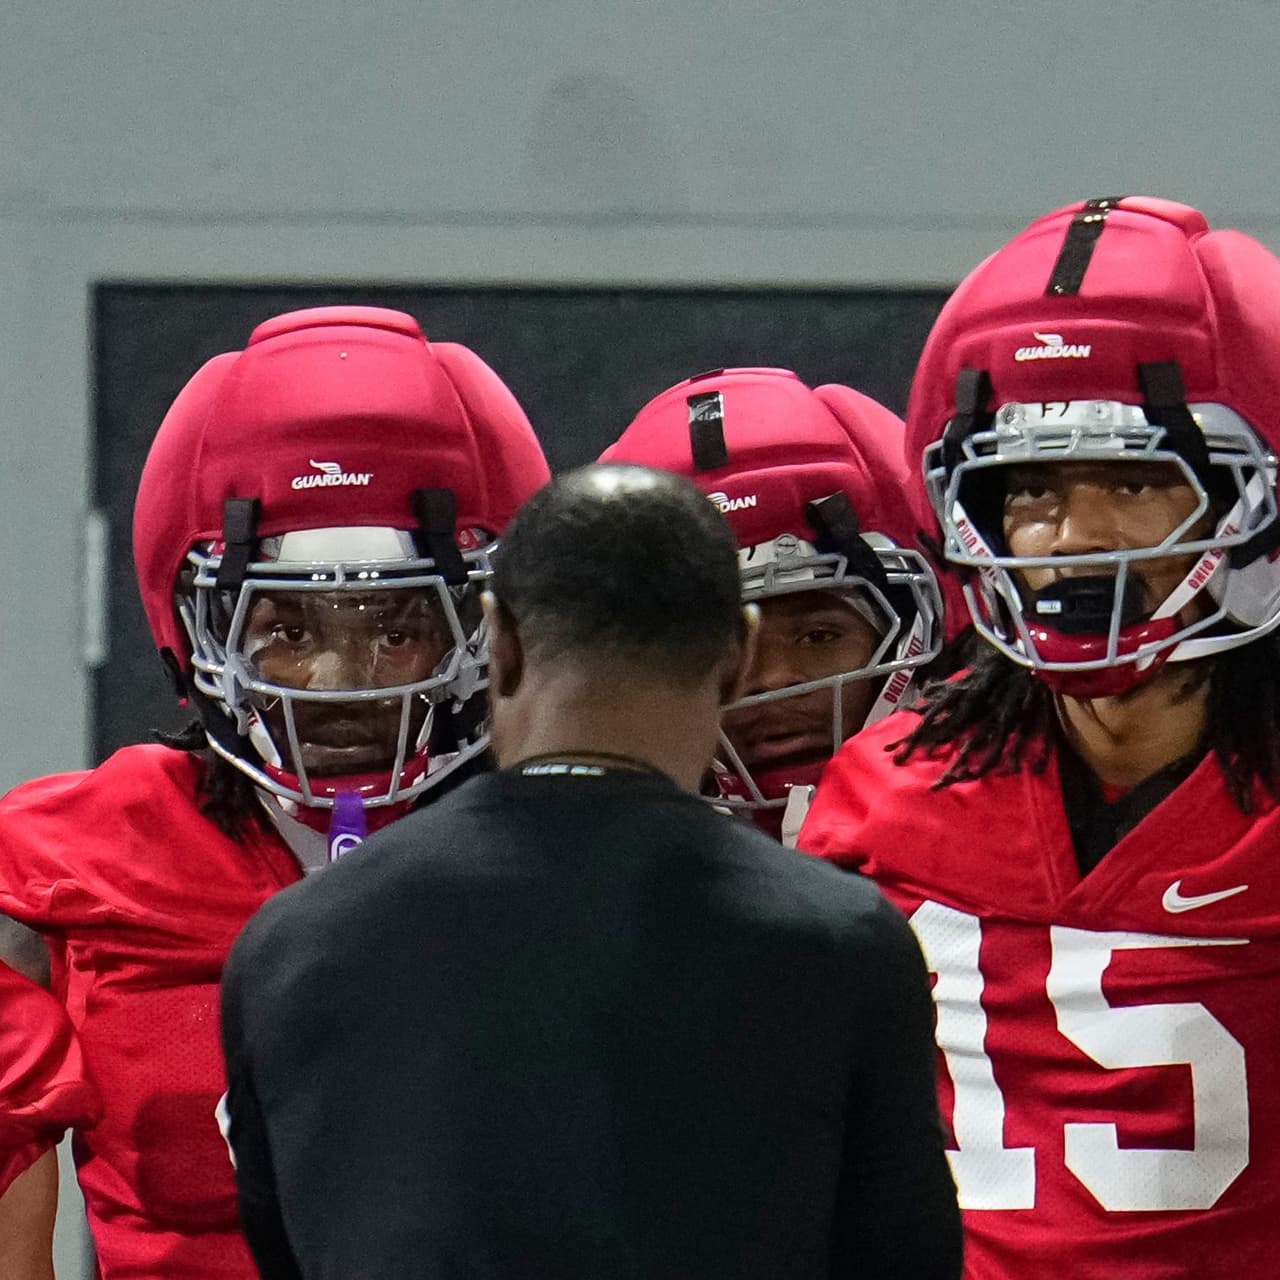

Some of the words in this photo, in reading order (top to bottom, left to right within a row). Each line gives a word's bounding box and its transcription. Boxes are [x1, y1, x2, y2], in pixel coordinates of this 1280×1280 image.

[1014, 344, 1091, 361] GUARDIAN
[291, 473, 370, 490] GUARDIAN
[908, 899, 1251, 1211] 15
